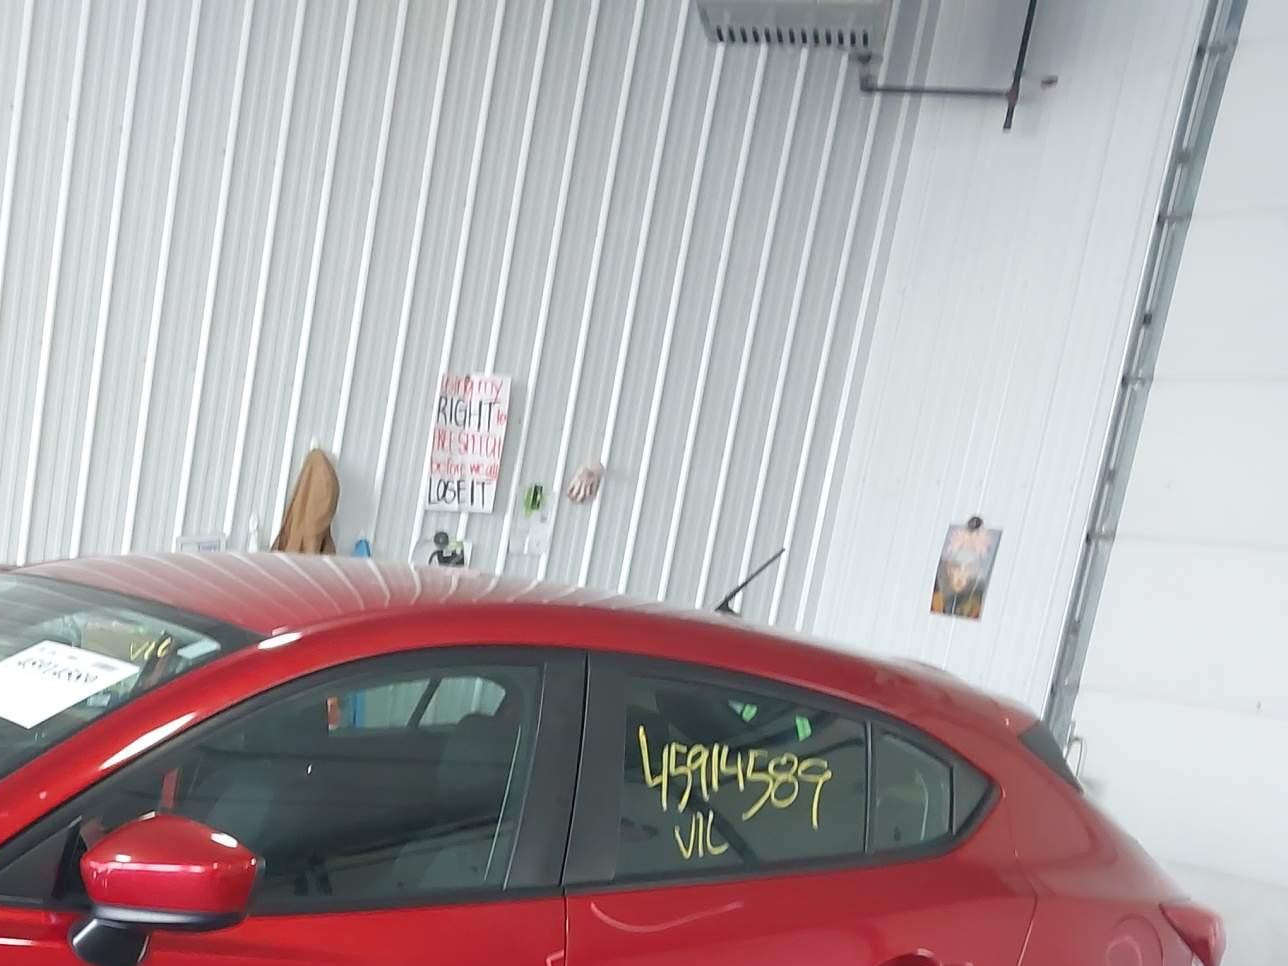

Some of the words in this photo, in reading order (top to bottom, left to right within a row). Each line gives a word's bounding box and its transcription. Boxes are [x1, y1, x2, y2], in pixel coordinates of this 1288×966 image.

[437, 396, 500, 432] RIGHT
[427, 476, 466, 505] LOSE
[470, 480, 494, 509] IT
[638, 724, 833, 830] 45914589
